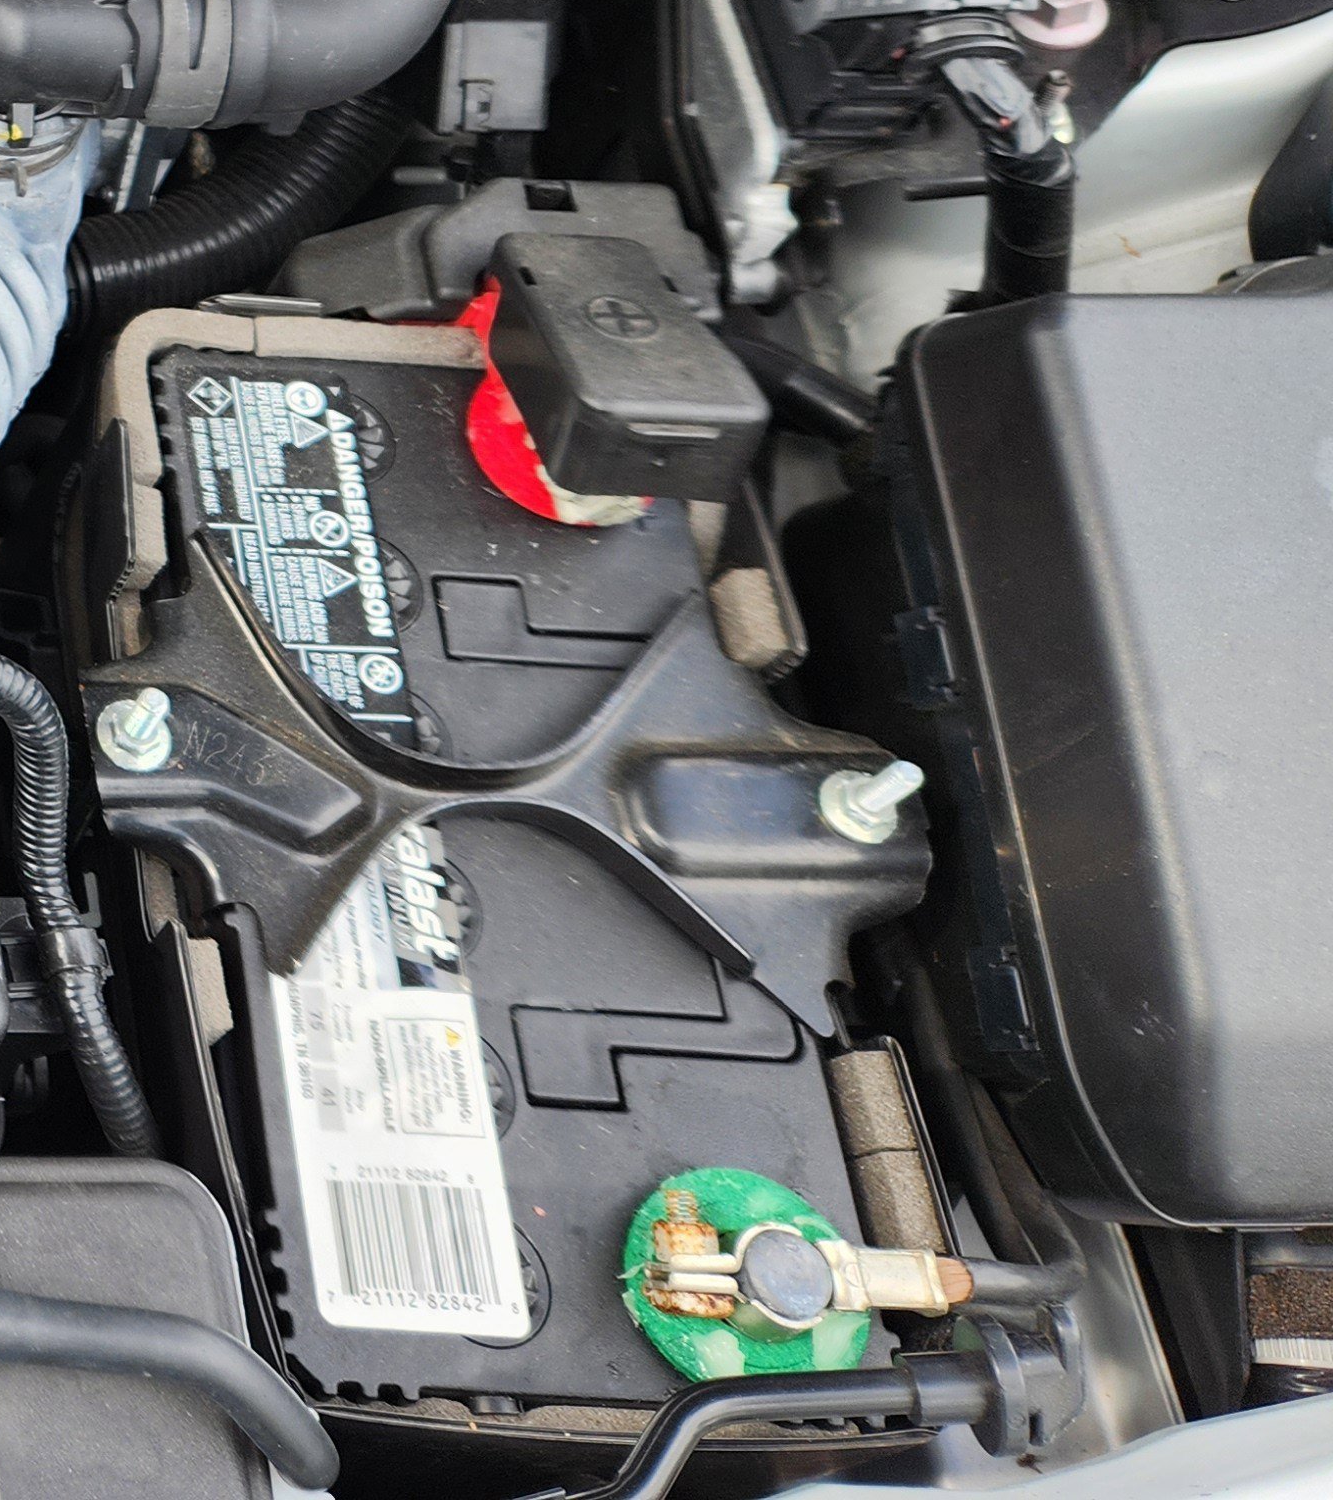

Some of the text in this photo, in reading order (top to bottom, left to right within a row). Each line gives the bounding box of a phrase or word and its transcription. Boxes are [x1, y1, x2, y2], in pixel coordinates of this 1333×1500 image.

[253, 383, 277, 434] EXPLOSIVE
[188, 417, 209, 434] GET
[207, 418, 225, 439] WITH
[191, 434, 215, 469] MEDICAL
[262, 436, 284, 468] GASES
[197, 470, 219, 491] HELP
[222, 419, 254, 522] FLUSH EYES IMMEDIATELY
[302, 496, 322, 510] NO
[261, 502, 283, 544] SMOKING
[276, 504, 297, 539] FLAMES
[290, 504, 311, 540] SPARKS
[333, 433, 393, 637] DANGER/POISON
[240, 532, 260, 560] READ
[270, 557, 287, 570] OR
[273, 572, 293, 606] SEVERE
[285, 557, 314, 639] CAUSE BLINDNESS
[299, 557, 330, 644] SULFURIC ACID CAN
[309, 653, 326, 664] OF
[339, 654, 358, 675] KEEP
[325, 653, 348, 701] THE REACH
[344, 677, 362, 694] OUT
[306, 1012, 326, 1030] 75
[318, 1088, 338, 1107] 41
[427, 1295, 485, 1313] 82842
